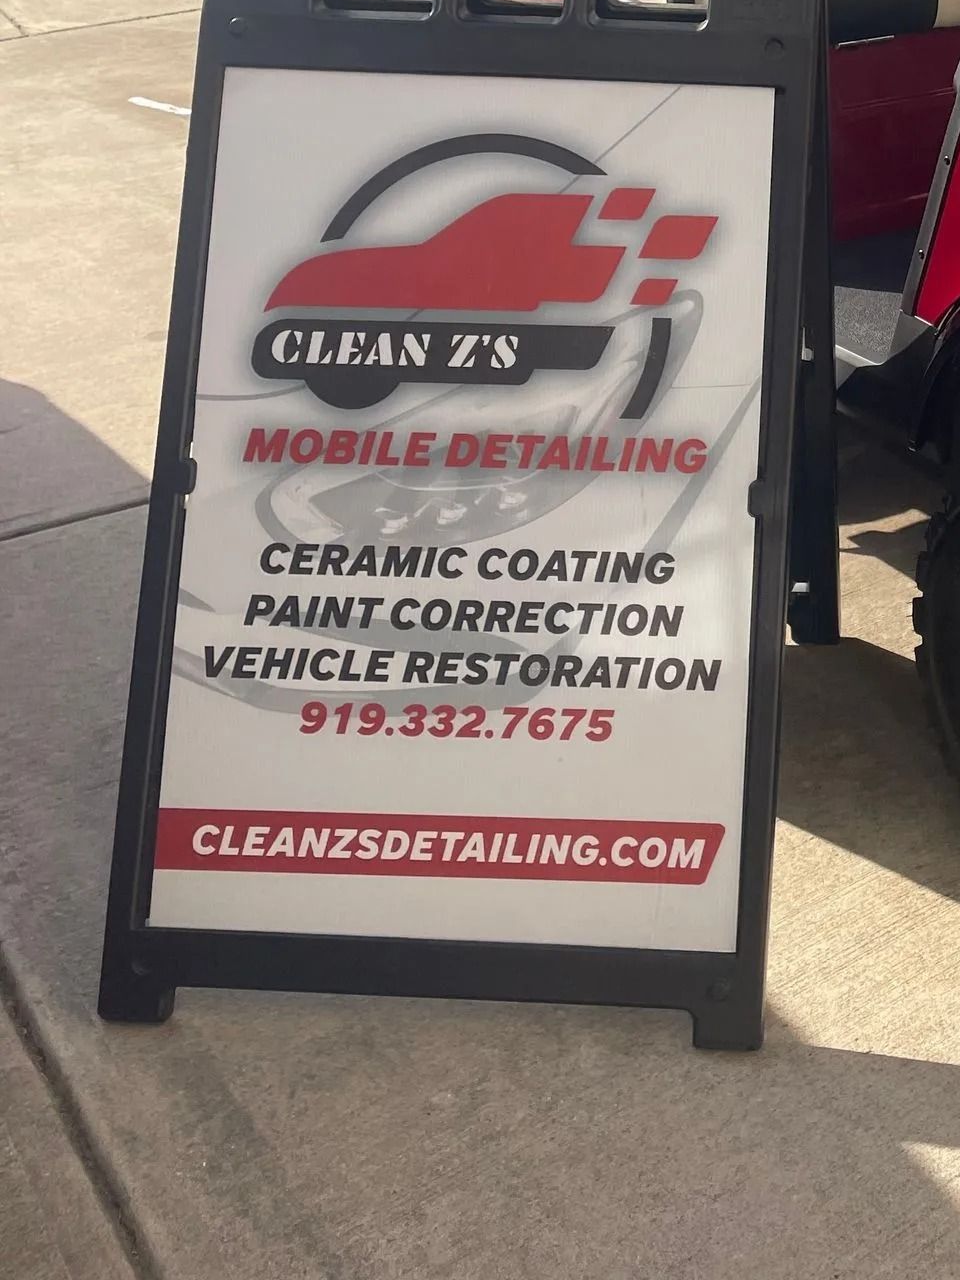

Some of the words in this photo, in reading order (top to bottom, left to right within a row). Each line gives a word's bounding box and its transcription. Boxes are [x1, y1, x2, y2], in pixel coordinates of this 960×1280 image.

[271, 329, 431, 367] CLEAN
[447, 334, 519, 369] Z'S
[243, 428, 437, 468] MOBILE
[444, 433, 708, 474] DETAILING
[260, 542, 468, 579] CERAMIC
[477, 548, 676, 585] COATING
[243, 594, 385, 629] PAINT
[390, 598, 685, 637] CORRECTION
[204, 645, 395, 683] VEHICLE
[402, 651, 723, 691] RESTORATION
[299, 701, 616, 742] 919.332.7675
[192, 824, 706, 869] CLEANZSDETAILING.COM
